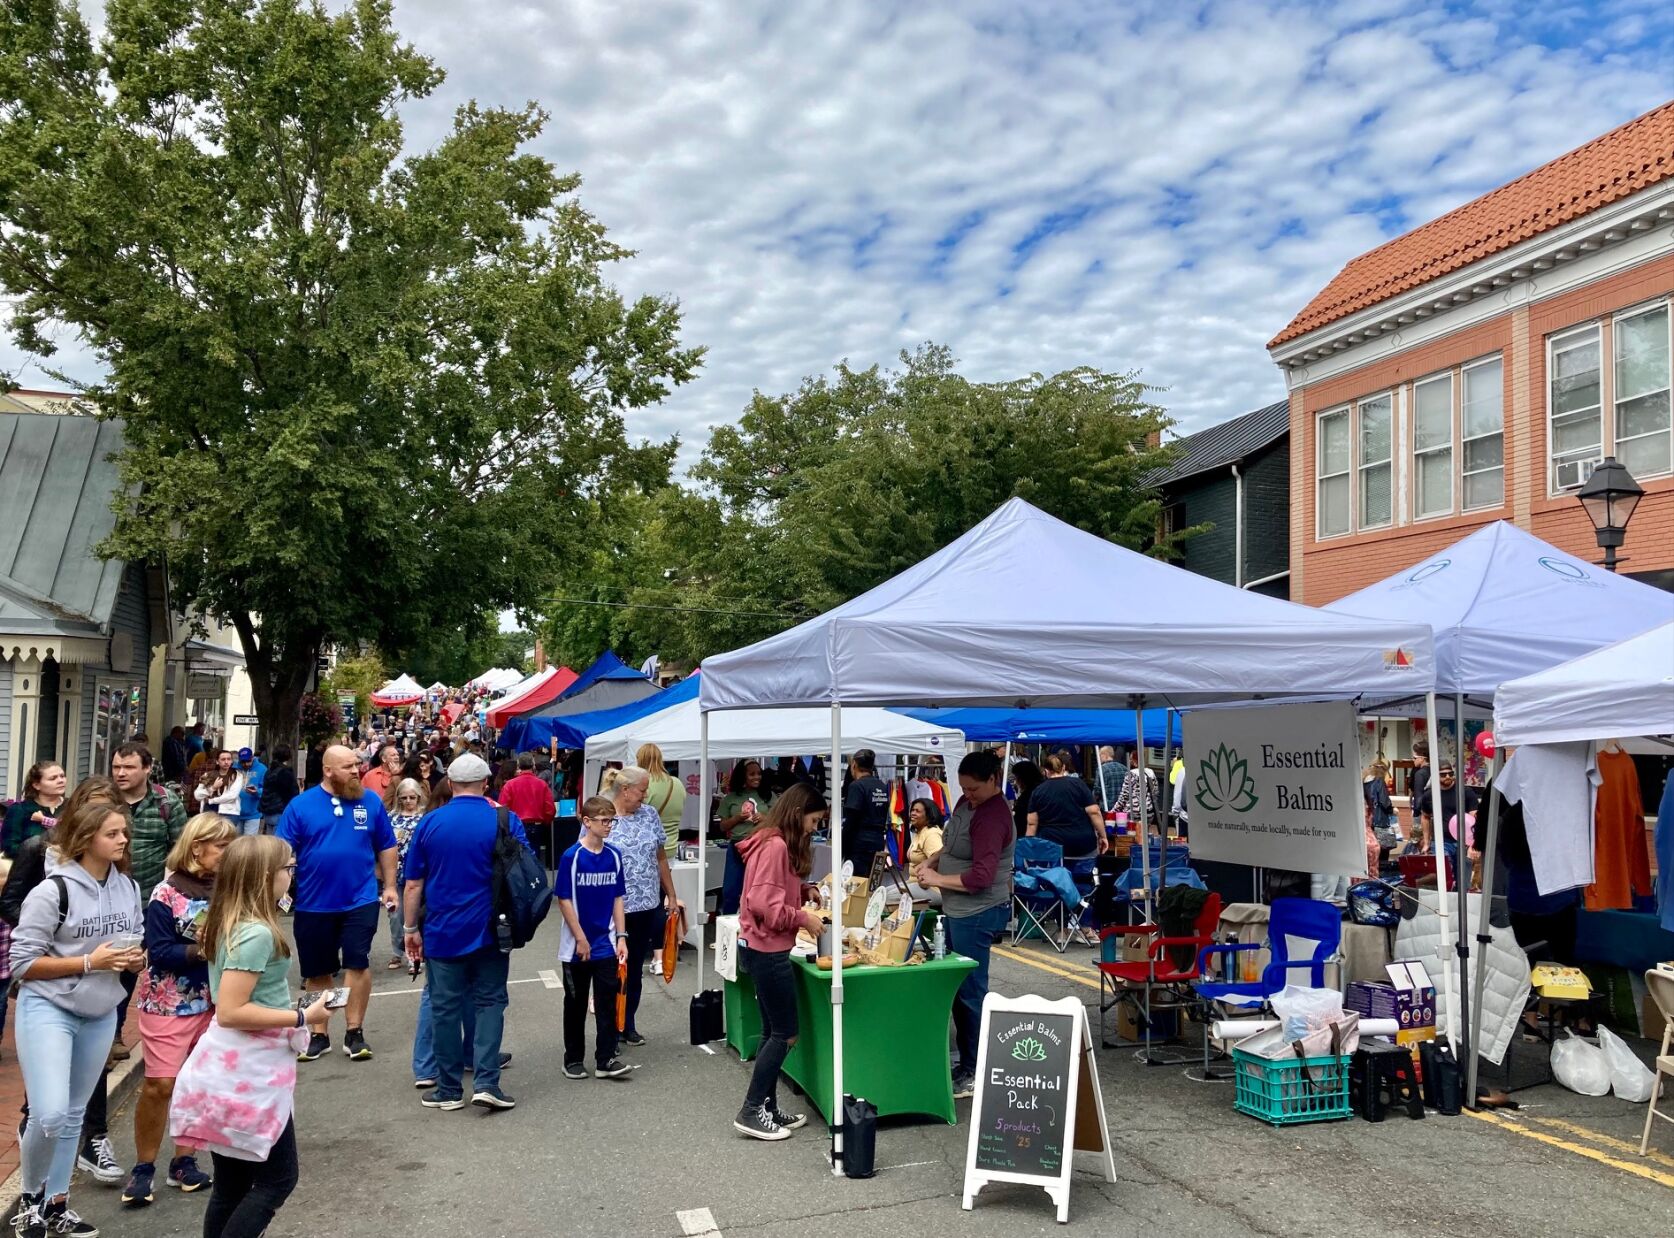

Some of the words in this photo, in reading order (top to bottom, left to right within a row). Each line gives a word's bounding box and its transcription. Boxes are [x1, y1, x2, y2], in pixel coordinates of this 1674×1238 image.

[1261, 742, 1345, 769] Essential
[1276, 784, 1334, 812] Balms
[1207, 820, 1223, 830] made
[1224, 822, 1251, 835] naturally,
[1251, 823, 1268, 833] made
[1269, 824, 1292, 838] locally,
[1292, 826, 1311, 837] made
[1311, 827, 1322, 837] for
[1322, 829, 1337, 841] you
[72, 919, 131, 939] JIU-JITSU
[82, 912, 127, 926] BATTLEFIELD
[997, 1020, 1035, 1044] Essential
[1037, 1022, 1062, 1047] Balms
[991, 1067, 1061, 1091] Essential
[1007, 1090, 1039, 1110] Pack
[1003, 1120, 1042, 1135] products
